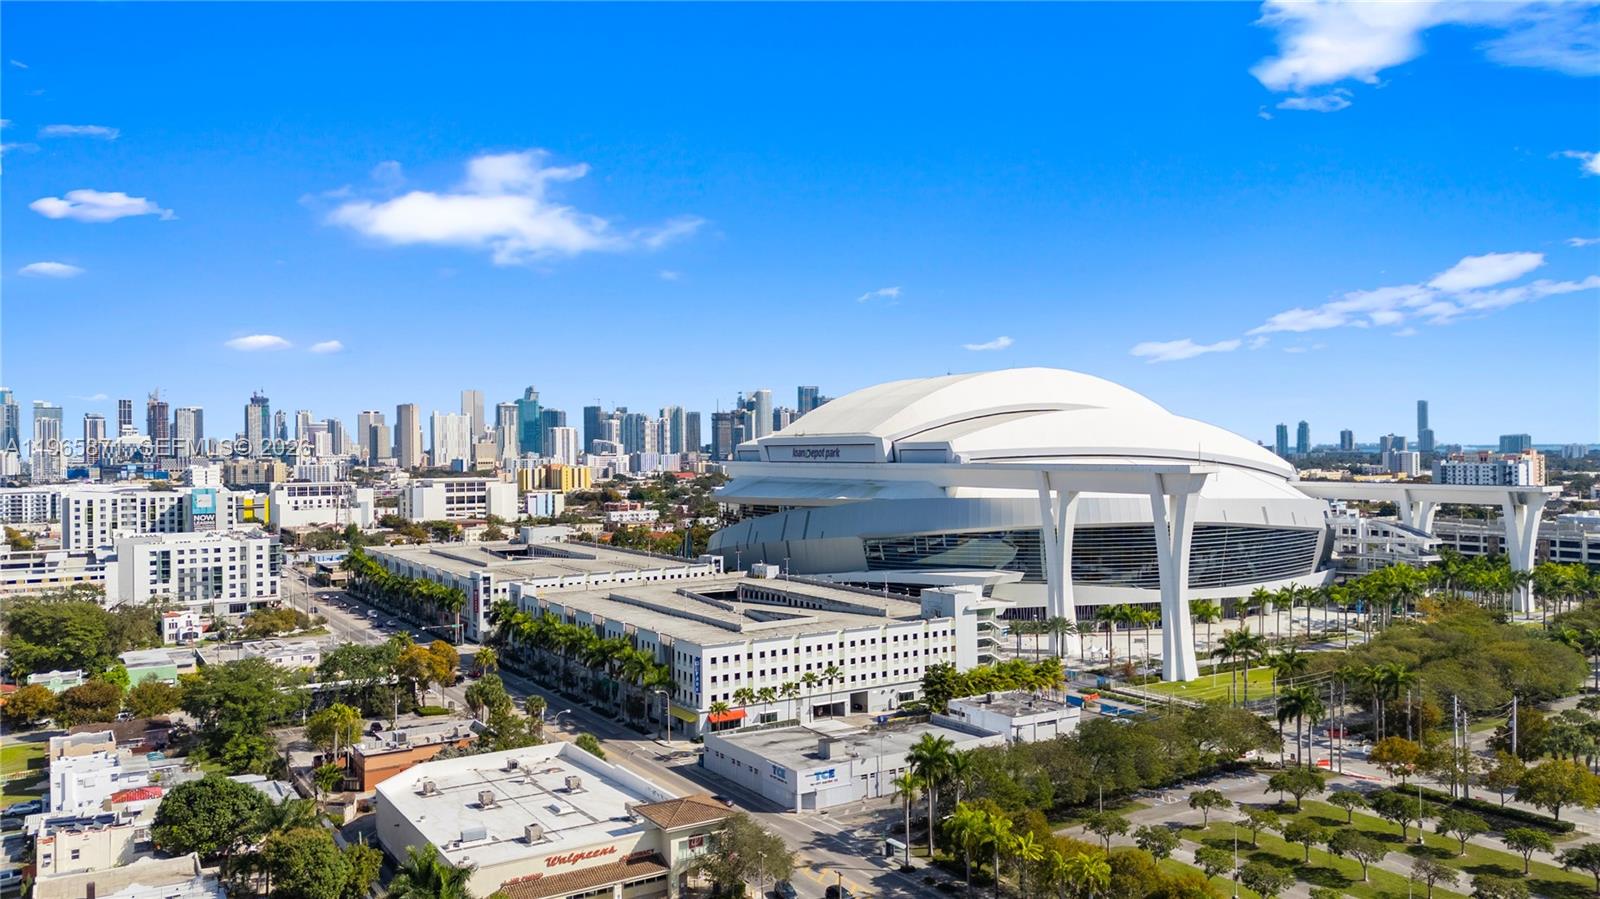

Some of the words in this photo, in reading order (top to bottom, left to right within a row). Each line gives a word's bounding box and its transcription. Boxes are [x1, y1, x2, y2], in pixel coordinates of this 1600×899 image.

[825, 447, 841, 461] park
[814, 768, 836, 781] TCE
[544, 845, 618, 868] Walgreens
